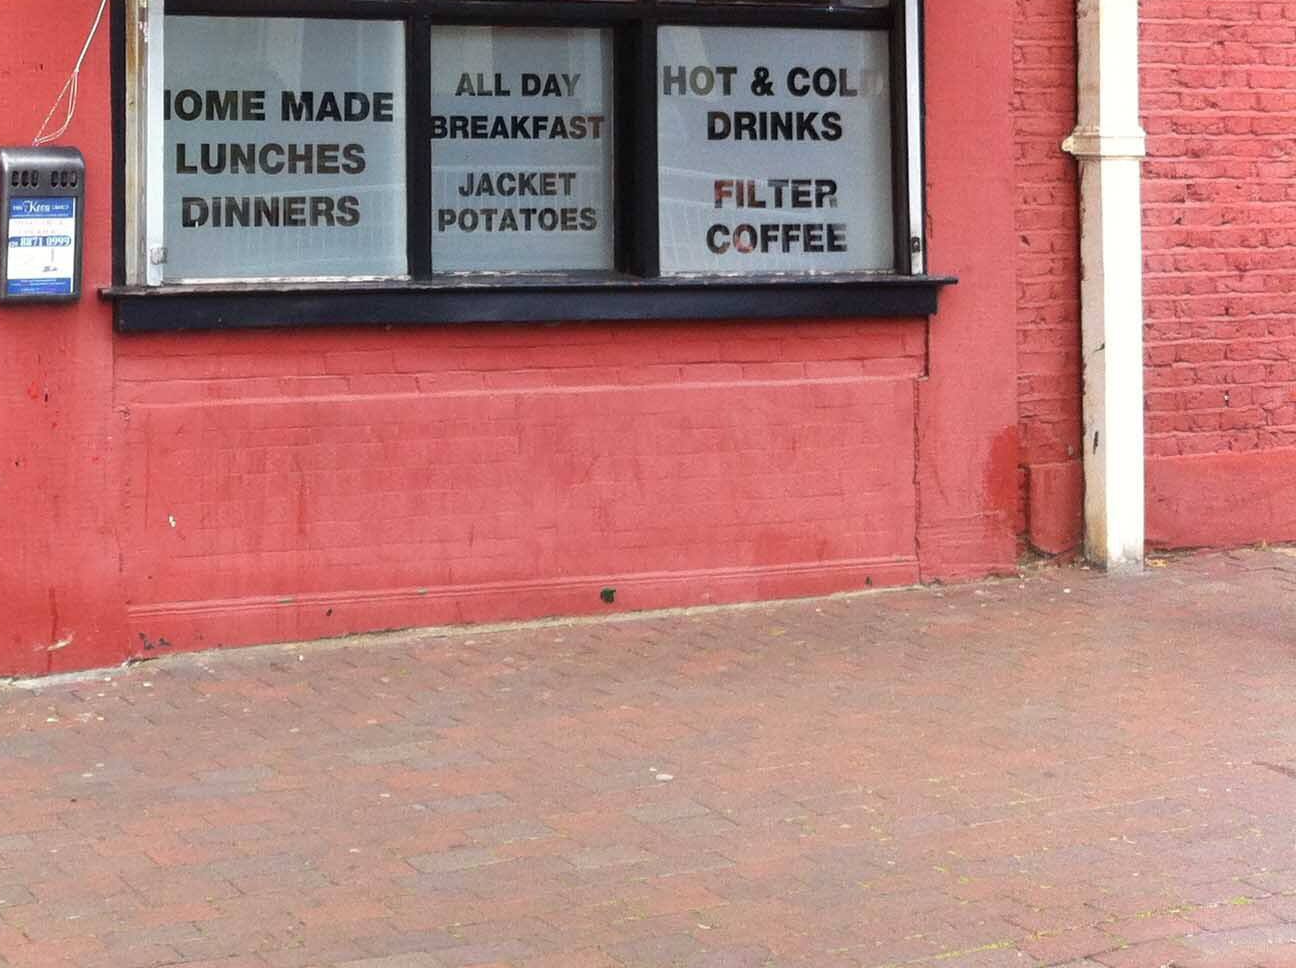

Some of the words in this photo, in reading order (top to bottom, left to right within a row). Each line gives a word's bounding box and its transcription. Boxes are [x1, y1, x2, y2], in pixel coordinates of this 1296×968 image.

[455, 73, 511, 97] ALL
[521, 73, 581, 97] DAY
[662, 65, 737, 97] HOT
[751, 66, 775, 97] &
[281, 90, 394, 122] MADE
[431, 115, 604, 140] BREAKFAST
[706, 111, 843, 141] DRINKS
[176, 143, 366, 175] LUNCHES
[458, 172, 576, 197] JACKET
[713, 179, 838, 209] FILTER
[181, 195, 361, 228] DINNERS
[437, 207, 598, 232] POTATOES
[706, 223, 848, 254] COFFEE
